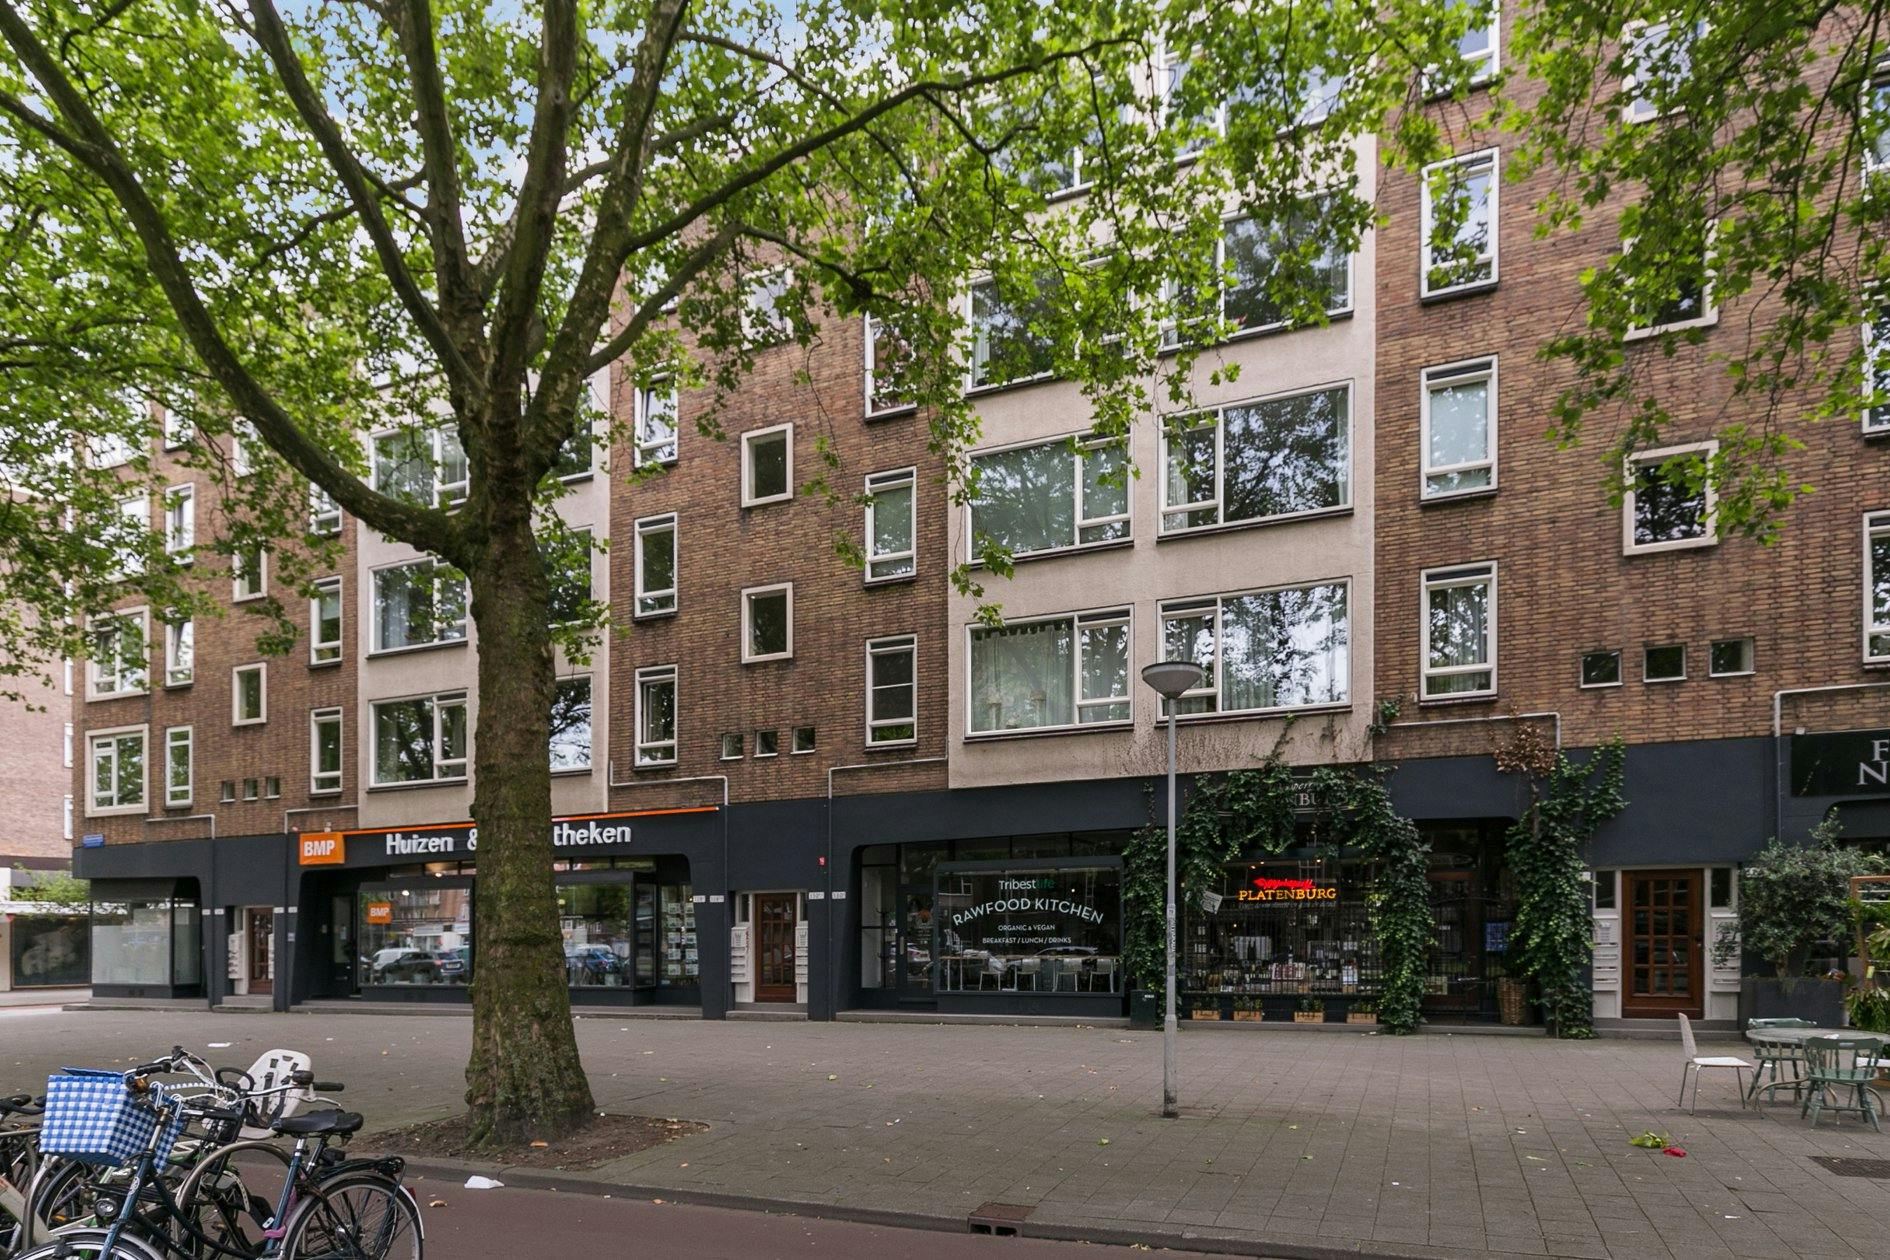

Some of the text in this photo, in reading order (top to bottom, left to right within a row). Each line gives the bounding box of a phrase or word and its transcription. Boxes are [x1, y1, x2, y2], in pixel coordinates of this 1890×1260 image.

[385, 821, 632, 855] Huizen & theken
[303, 840, 336, 857] BMP
[1239, 887, 1337, 901] PLATENBURG
[369, 906, 390, 918] BMP
[952, 898, 1104, 926] RAWFOOD KITCHEN
